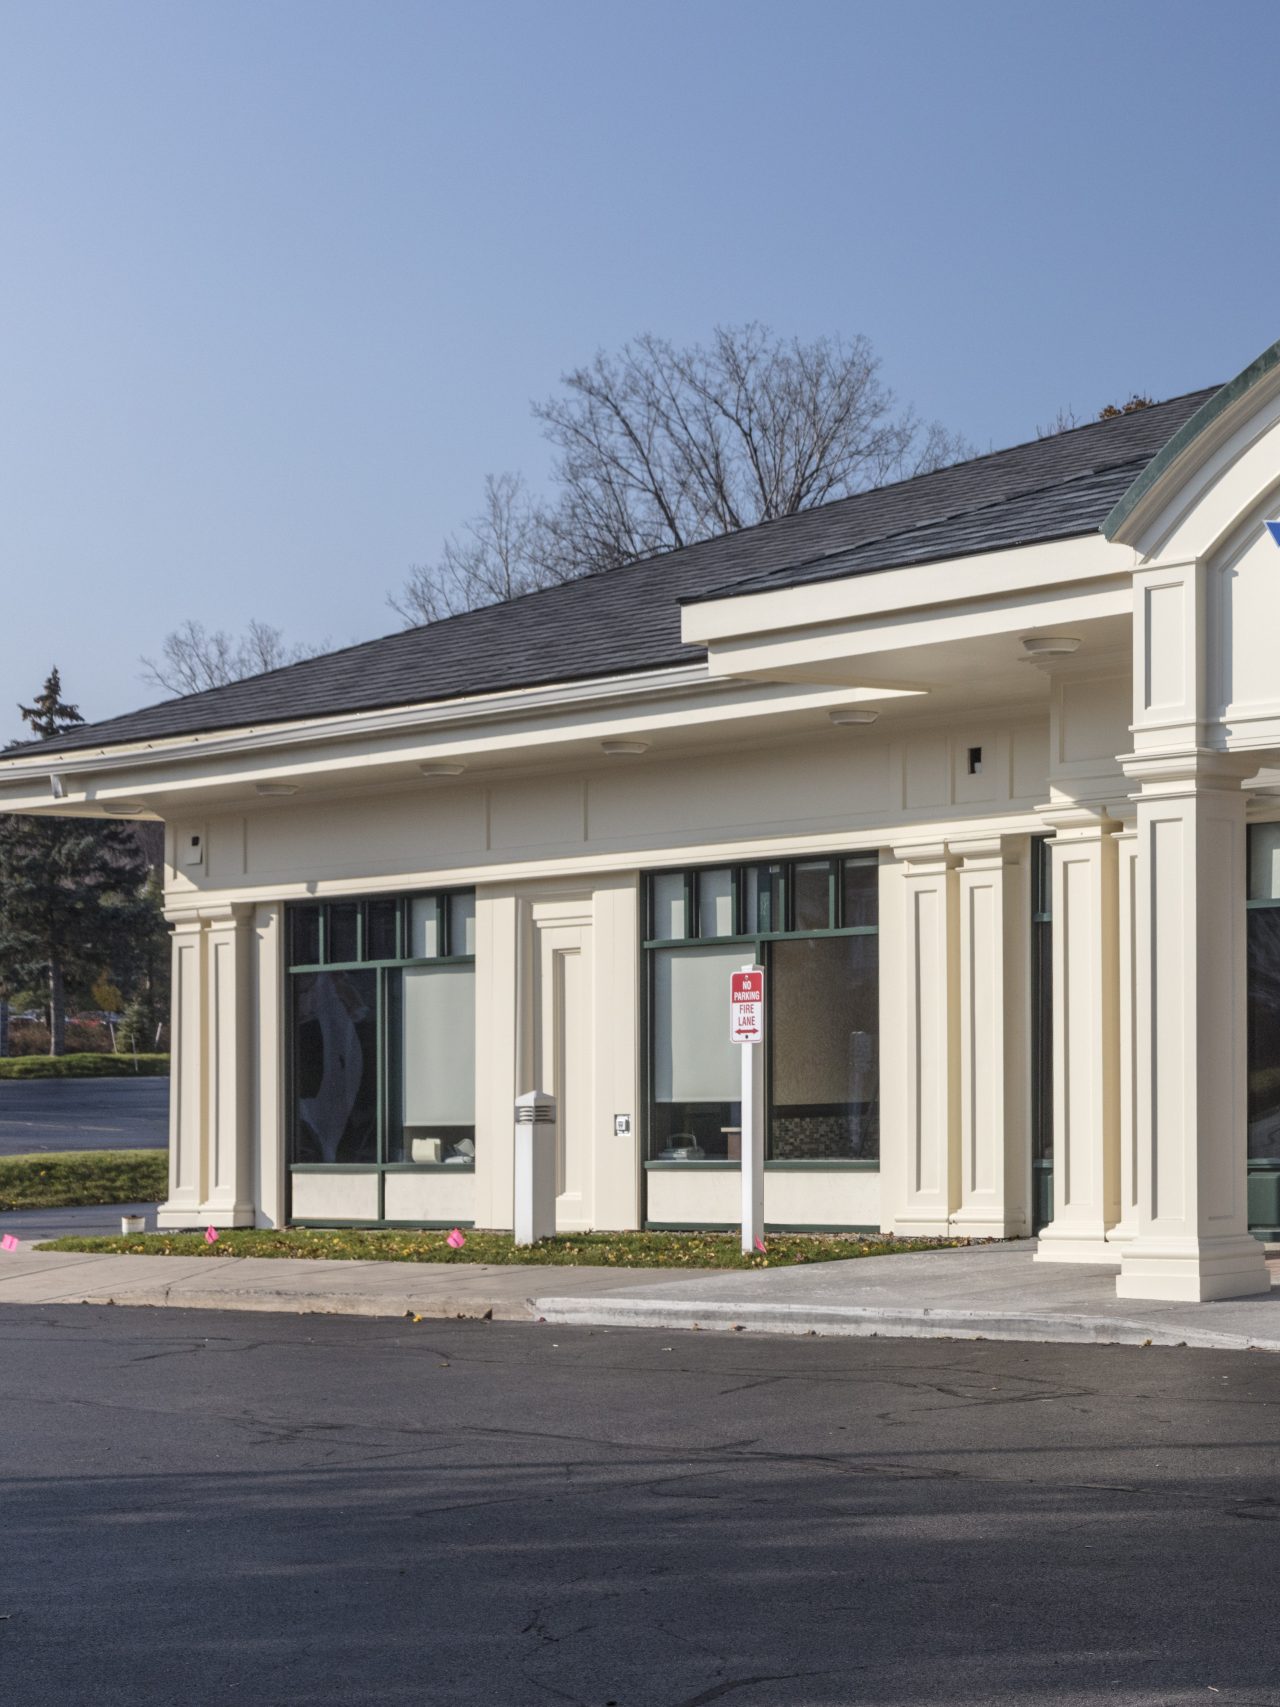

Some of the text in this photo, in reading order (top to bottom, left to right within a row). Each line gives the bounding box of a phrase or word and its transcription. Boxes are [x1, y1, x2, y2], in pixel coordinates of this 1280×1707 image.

[742, 981, 752, 990] NO
[733, 991, 760, 1001] PARKING
[739, 1004, 754, 1014] FIRE
[738, 1016, 756, 1026] LANE
